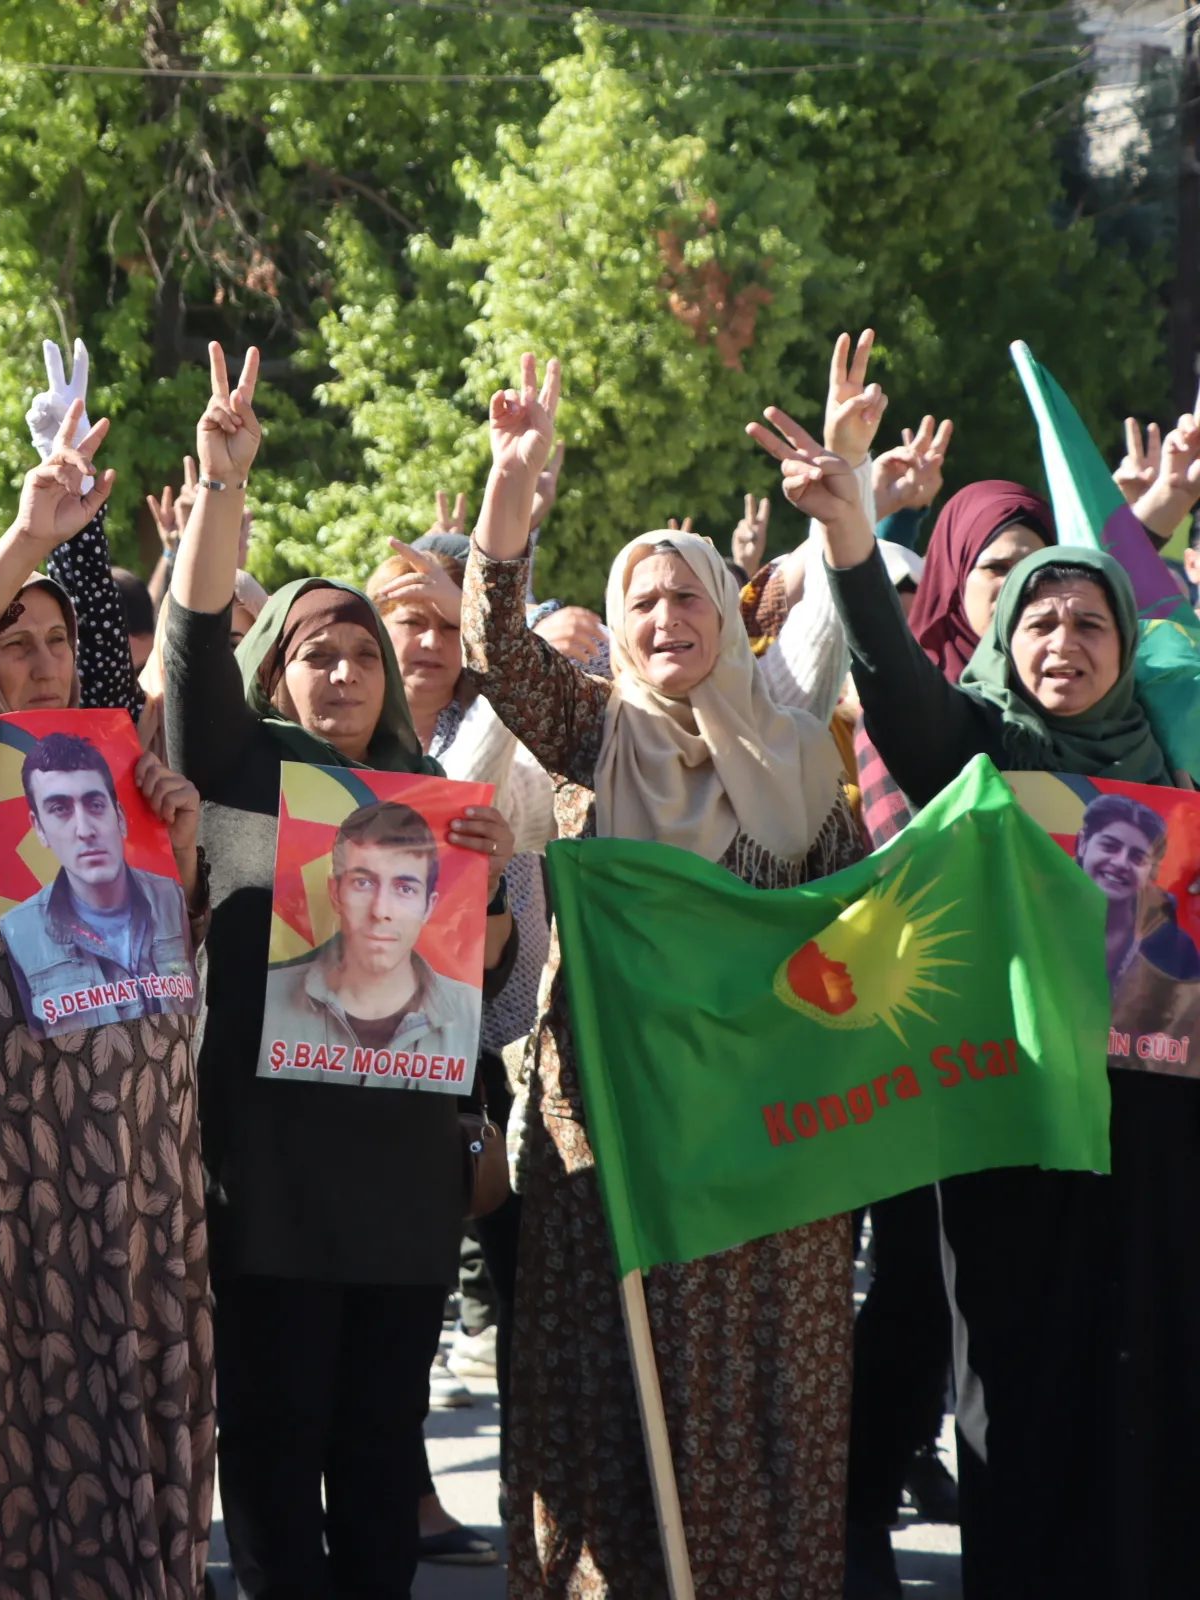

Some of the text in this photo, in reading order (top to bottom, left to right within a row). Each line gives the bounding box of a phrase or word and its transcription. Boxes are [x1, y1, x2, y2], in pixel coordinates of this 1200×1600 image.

[43, 978, 138, 1024] Ş.DEMHAT
[270, 1040, 467, 1083] Ş.BAZ MORDEM
[761, 1064, 922, 1147] Kongra
